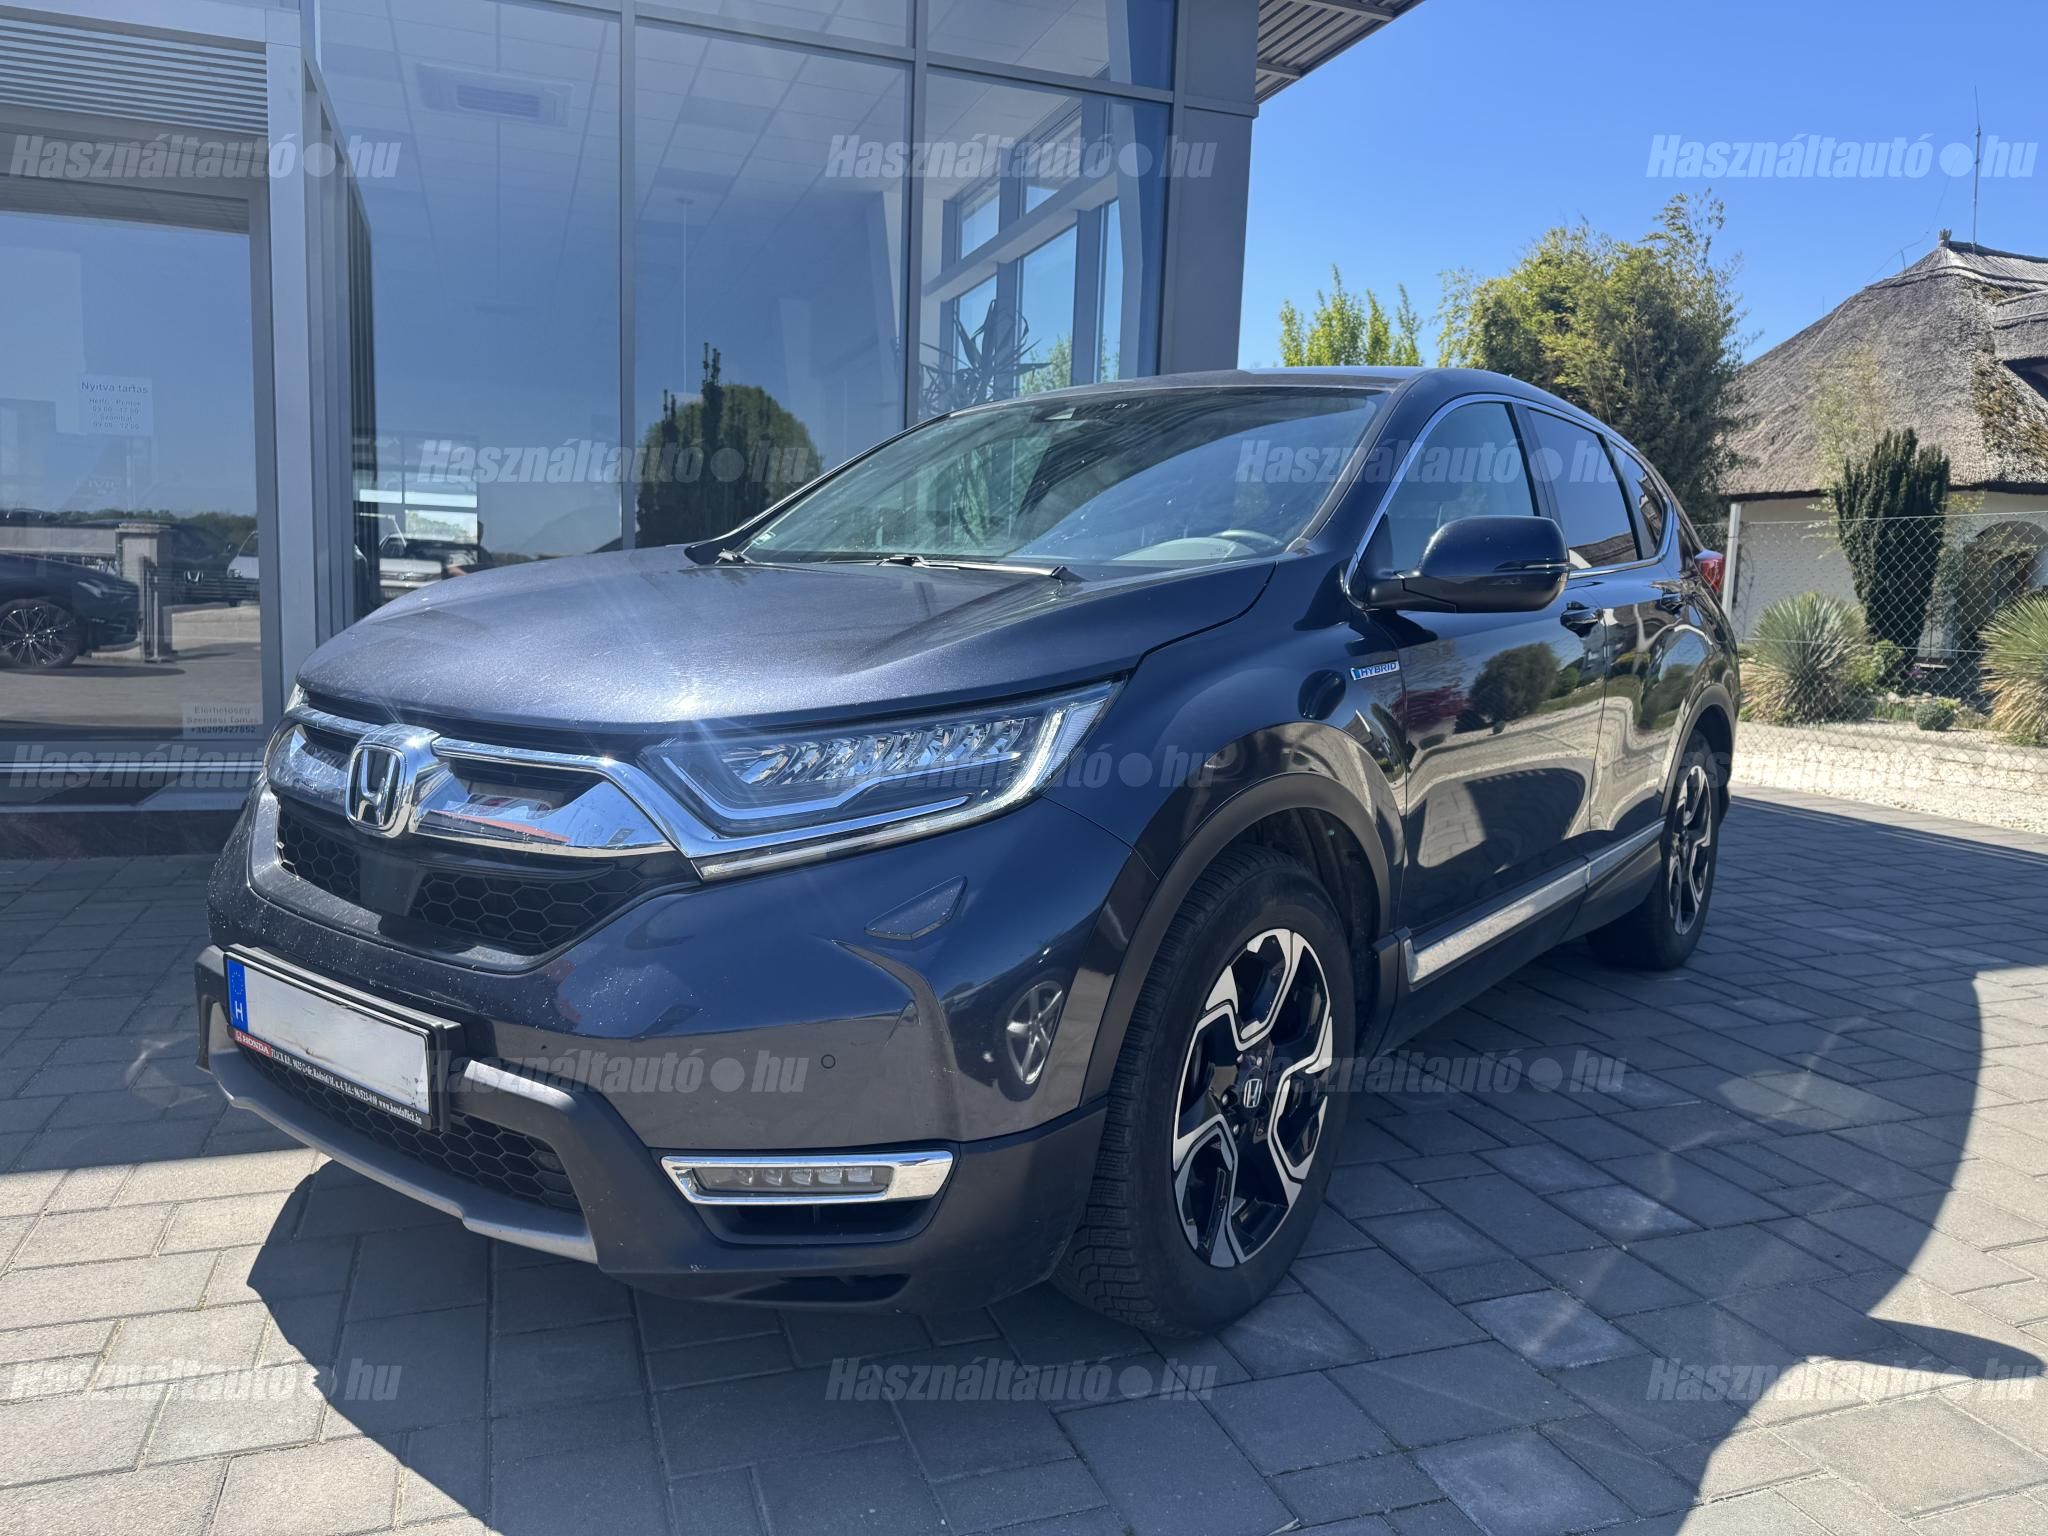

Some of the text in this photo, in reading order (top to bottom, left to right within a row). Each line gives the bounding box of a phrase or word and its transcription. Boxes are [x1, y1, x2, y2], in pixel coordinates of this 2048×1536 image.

[1360, 662, 1397, 677] HYBRID
[235, 1000, 244, 1022] H
[242, 1035, 270, 1055] HONDA
